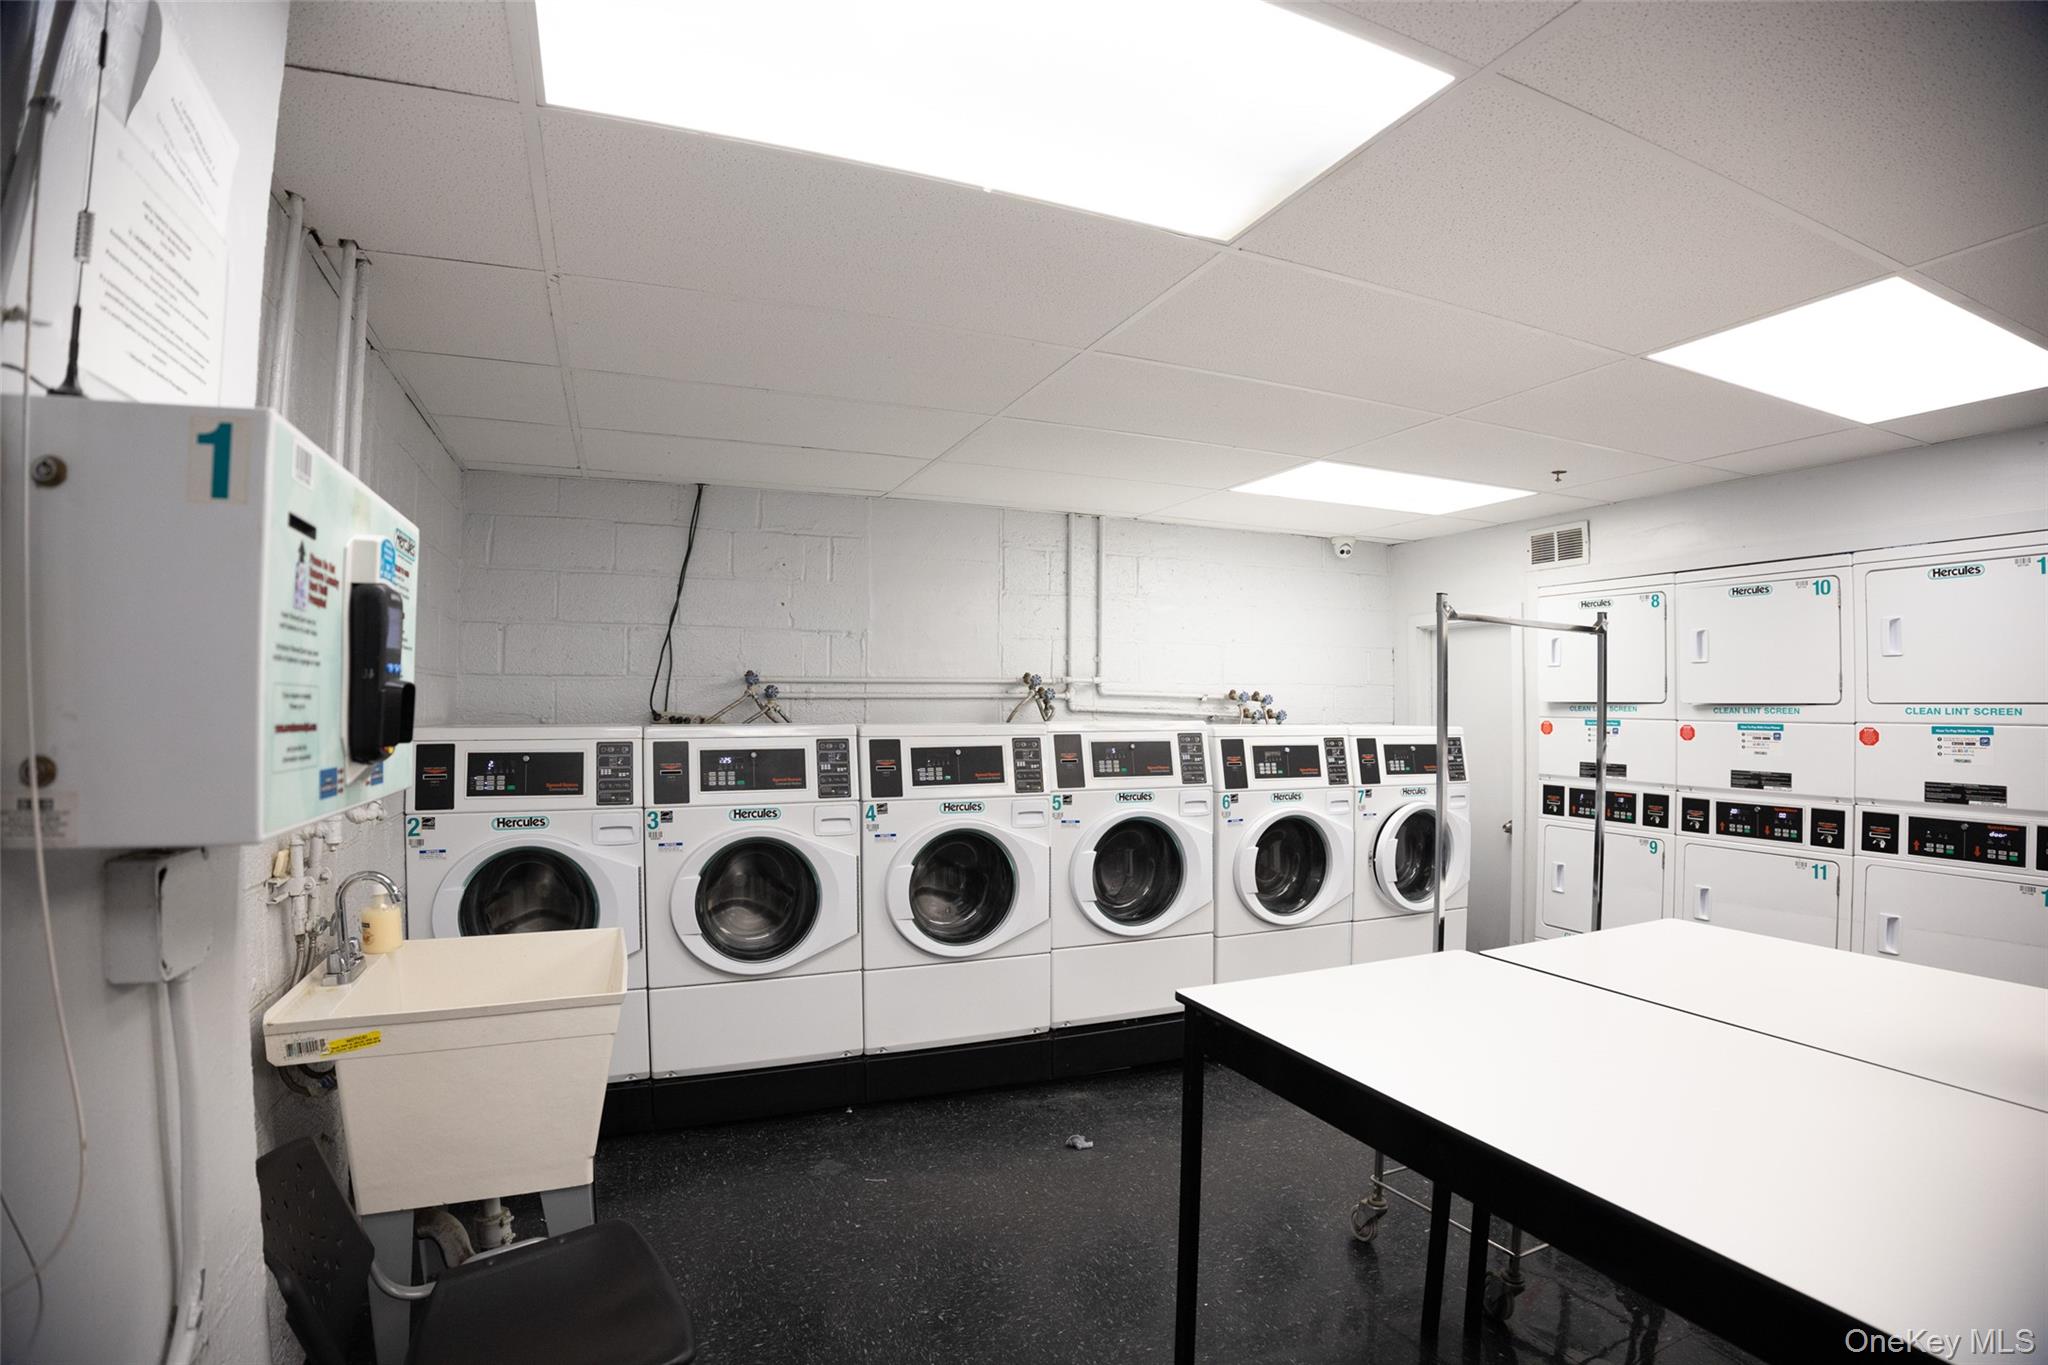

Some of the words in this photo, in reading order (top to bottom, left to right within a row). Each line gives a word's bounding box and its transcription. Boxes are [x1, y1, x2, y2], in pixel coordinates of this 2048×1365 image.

[197, 422, 232, 499] 1
[1932, 565, 1982, 578] Hercules
[1731, 585, 1770, 597] Hercules
[1812, 579, 1831, 596] 10
[1580, 599, 1611, 608] Hercules
[1651, 594, 1660, 608] 8
[1764, 707, 1800, 715] SCREEN
[1904, 707, 1941, 715] CLEAN
[1945, 707, 1970, 715] LINT
[1973, 707, 2023, 716] SCREEN
[1118, 792, 1153, 802] Hercules
[1273, 792, 1302, 801] Hercules
[1358, 790, 1365, 804] 7
[1402, 787, 1427, 796] Hercules
[943, 802, 983, 812] Hercules
[1052, 795, 1062, 811] 5
[1222, 794, 1230, 809] 6
[733, 808, 778, 819] Hercules
[865, 804, 876, 822] 4
[496, 817, 546, 828] Hercules
[647, 811, 659, 829] 3
[407, 817, 420, 837] 2
[1649, 840, 1658, 855] 9
[1811, 863, 1828, 880] 11
